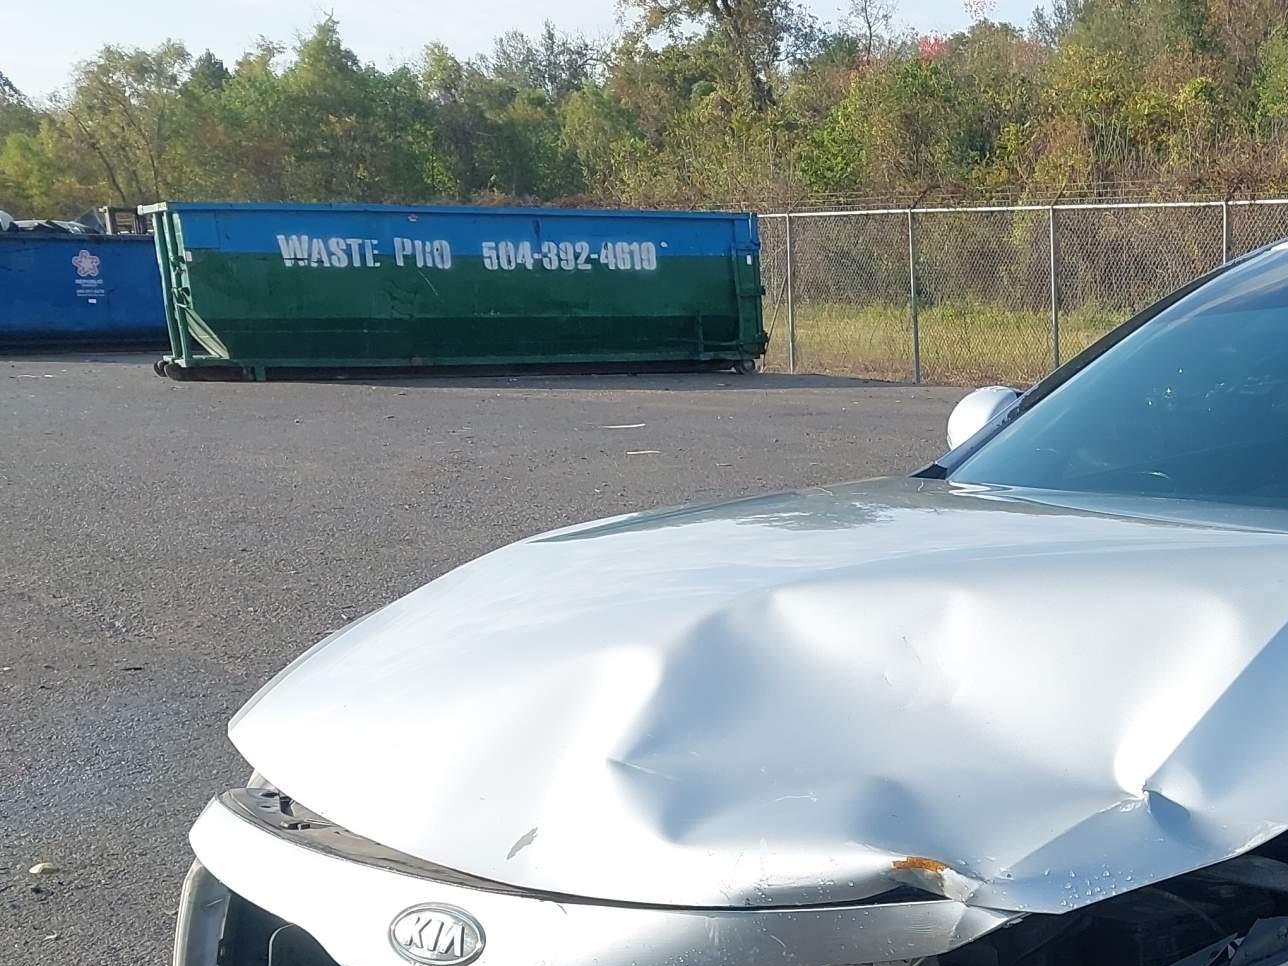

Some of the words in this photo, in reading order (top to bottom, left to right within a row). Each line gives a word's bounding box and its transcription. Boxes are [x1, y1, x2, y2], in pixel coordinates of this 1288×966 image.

[276, 235, 381, 267] WASTE
[394, 237, 452, 269] PRO
[482, 241, 657, 270] 504-392-4619
[404, 915, 465, 958] KIA
